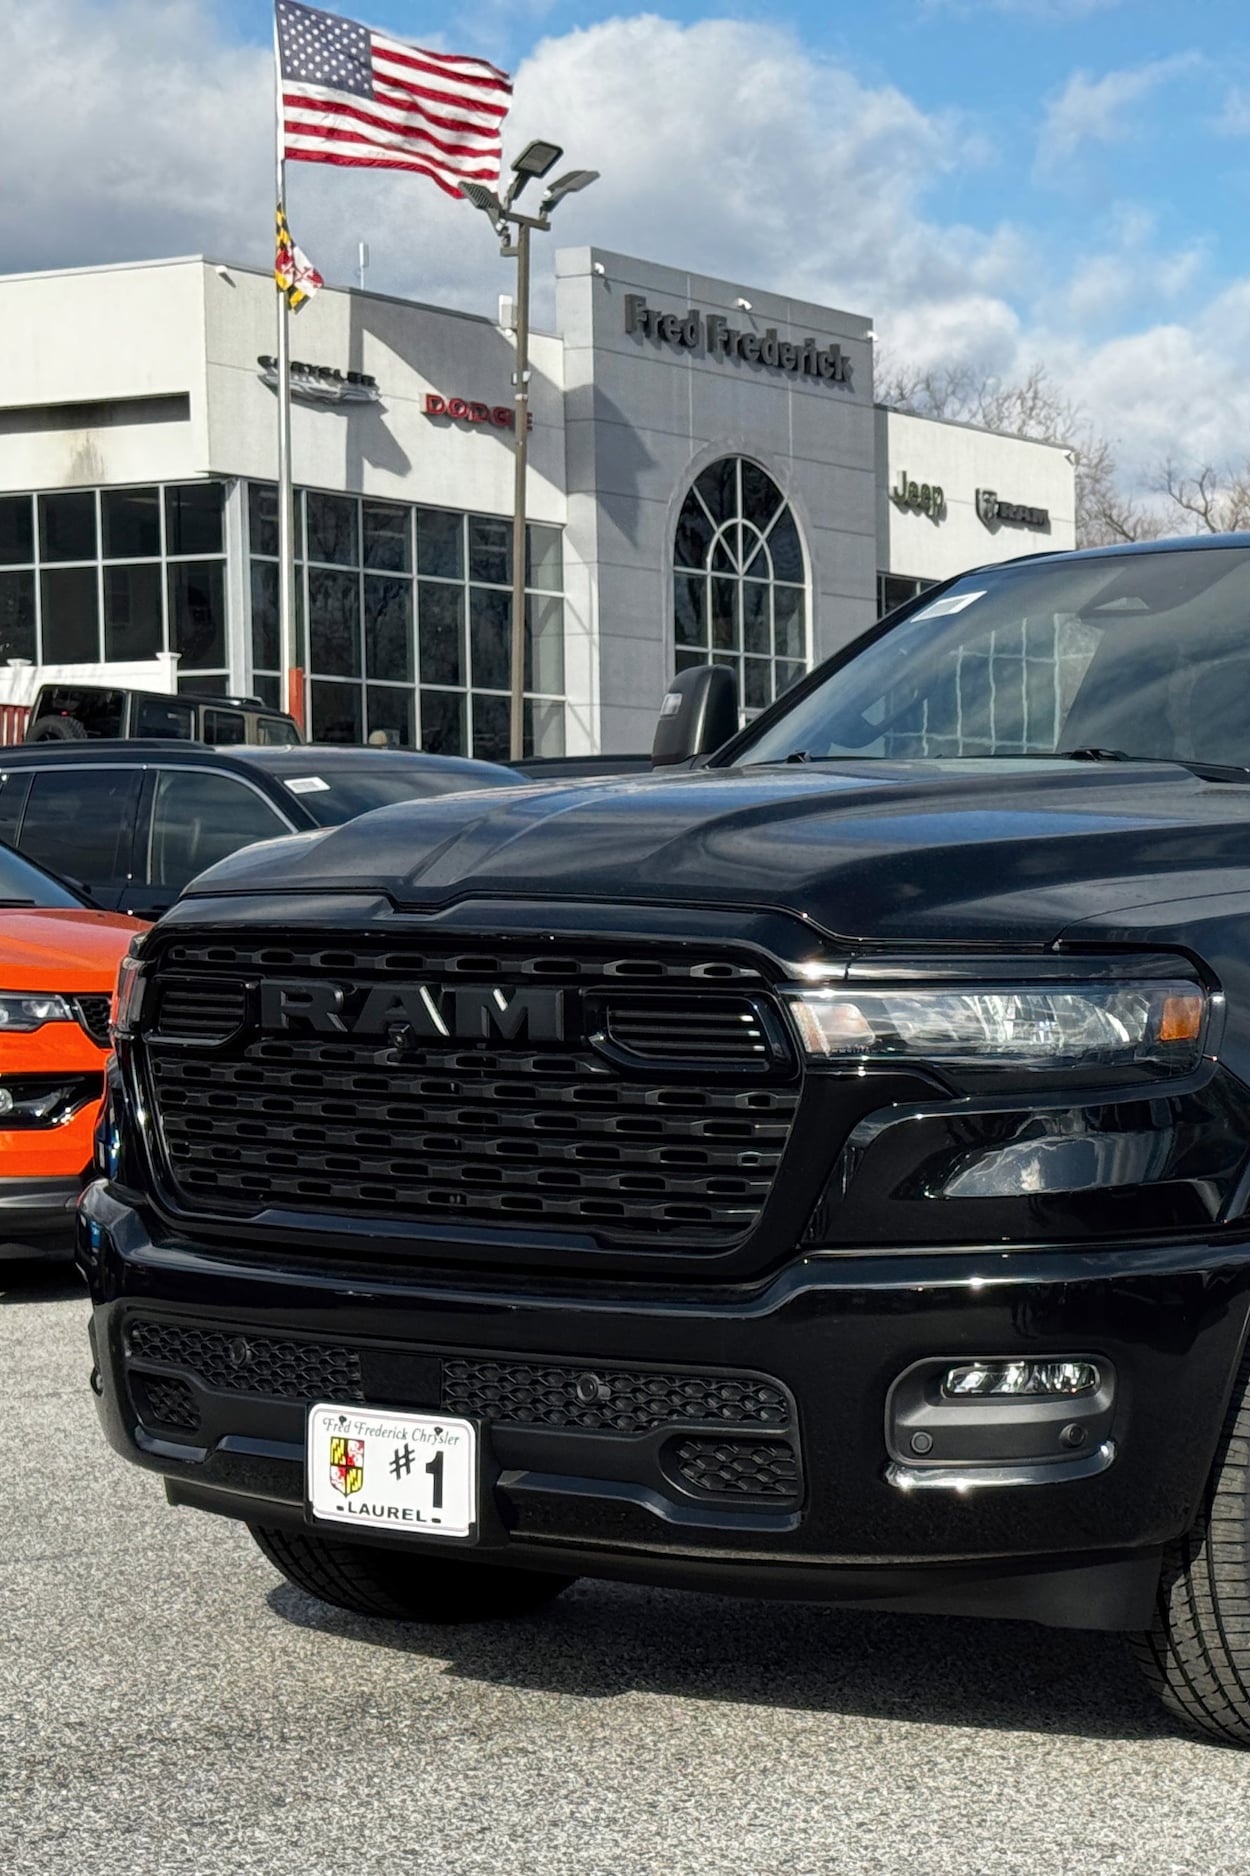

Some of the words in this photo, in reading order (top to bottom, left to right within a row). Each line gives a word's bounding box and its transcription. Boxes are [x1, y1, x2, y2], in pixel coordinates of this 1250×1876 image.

[623, 293, 700, 348] Fred
[706, 313, 851, 382] Frederick
[892, 470, 944, 519] Jeep
[998, 501, 1049, 525] RAM
[259, 978, 565, 1042] RAM
[322, 1416, 352, 1434] Fred
[353, 1421, 408, 1441] Frederick
[411, 1427, 460, 1446] Chrysler
